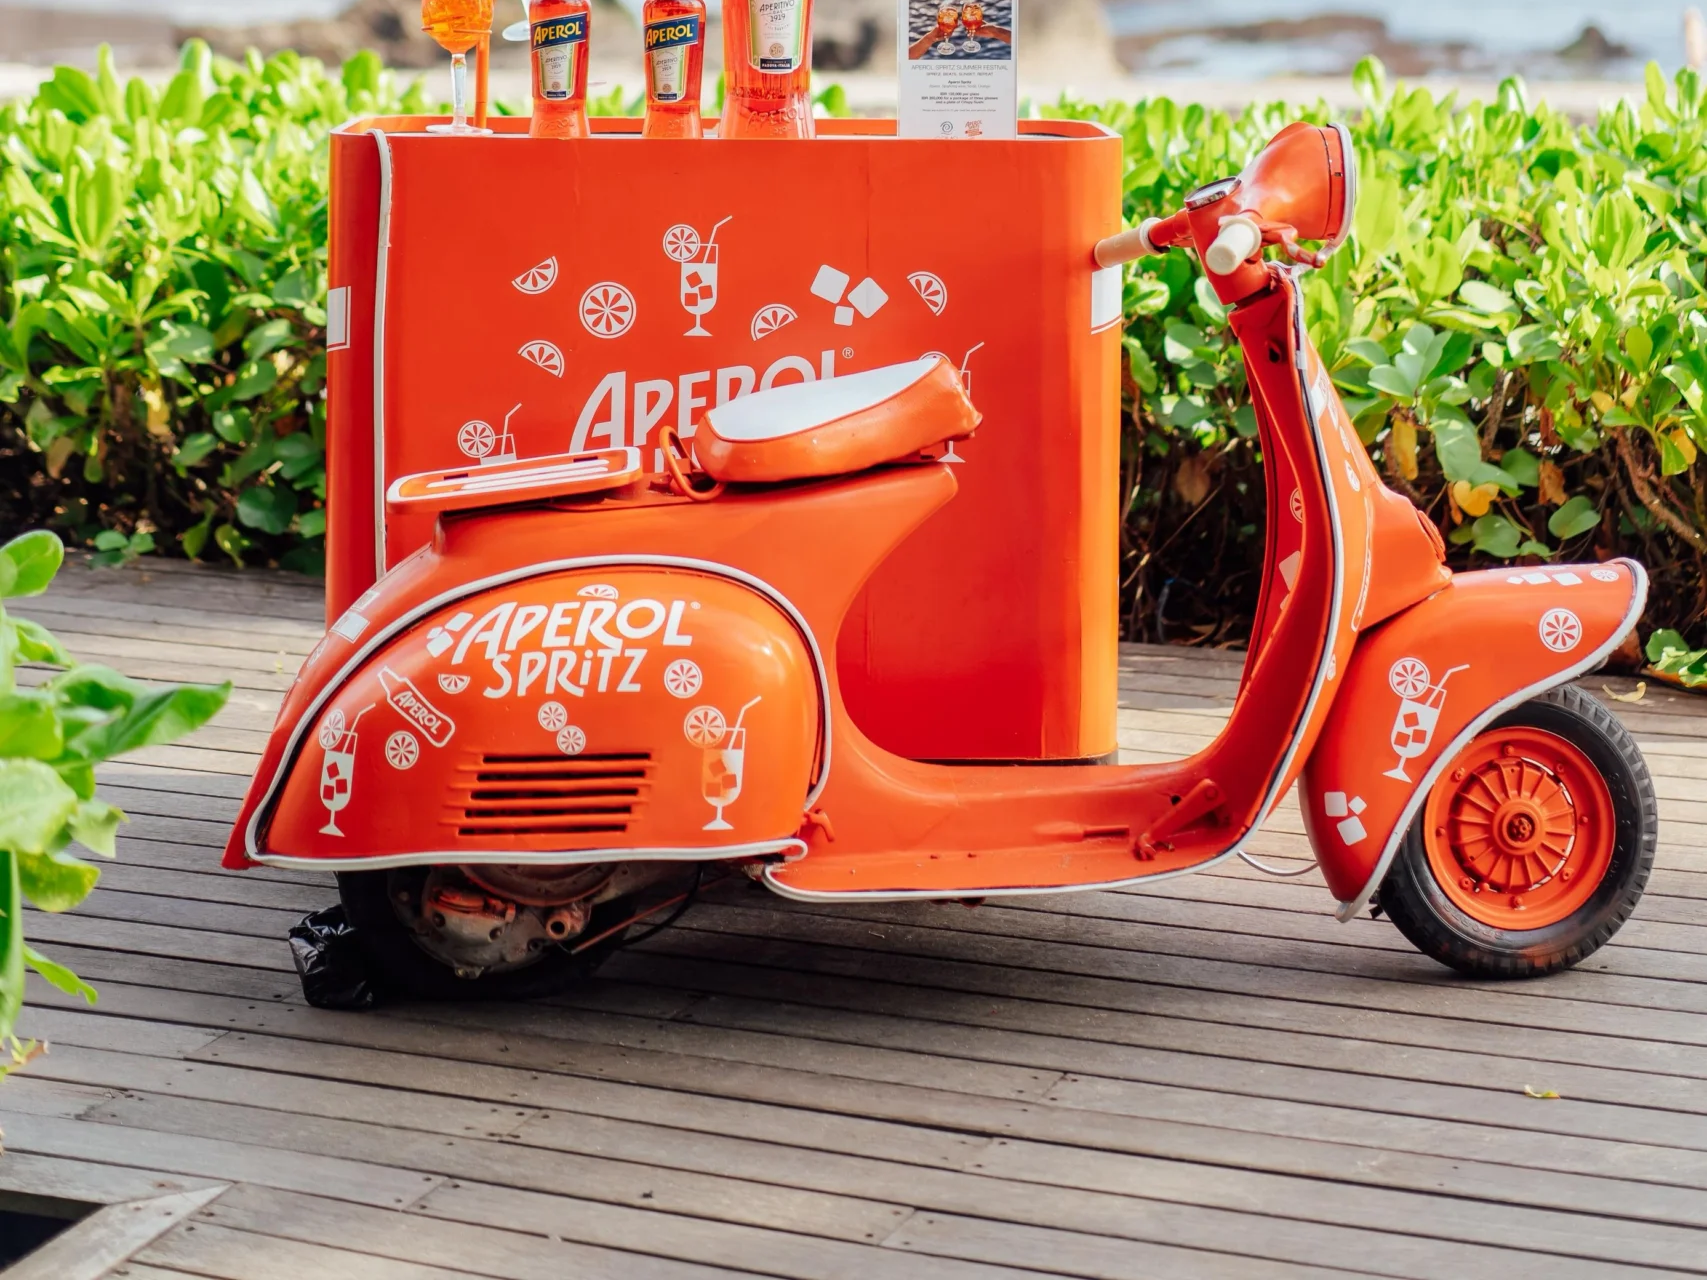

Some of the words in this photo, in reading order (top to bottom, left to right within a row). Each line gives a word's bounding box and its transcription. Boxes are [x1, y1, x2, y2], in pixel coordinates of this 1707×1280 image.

[760, 0, 795, 12] APERITIVO
[770, 14, 786, 22] 1919
[533, 21, 582, 45] APEROL
[645, 24, 693, 48] APEROL
[392, 690, 442, 735] APEROL
